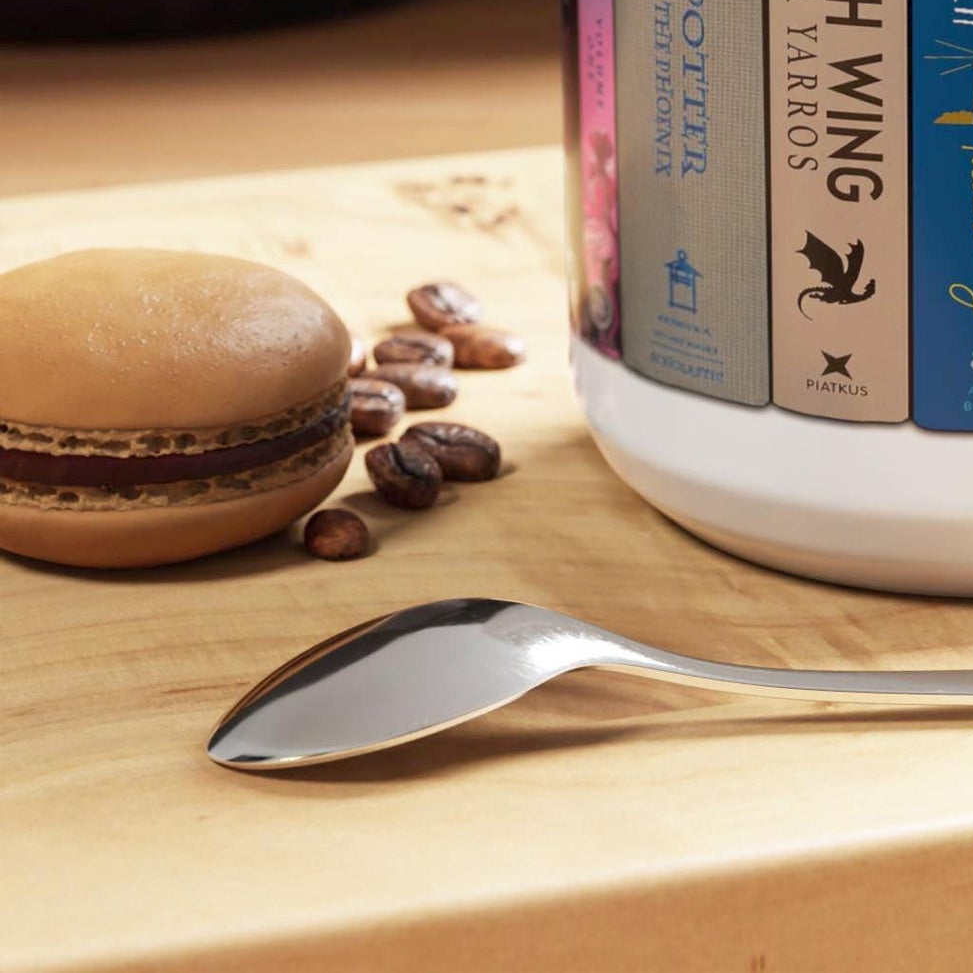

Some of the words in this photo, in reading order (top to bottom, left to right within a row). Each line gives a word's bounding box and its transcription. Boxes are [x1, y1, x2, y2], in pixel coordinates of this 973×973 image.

[654, 0, 673, 54] THE
[654, 56, 674, 178] PHOENIX
[786, 24, 819, 172] YARROS
[825, 53, 884, 203] WING
[806, 378, 869, 397] PIATKUS
